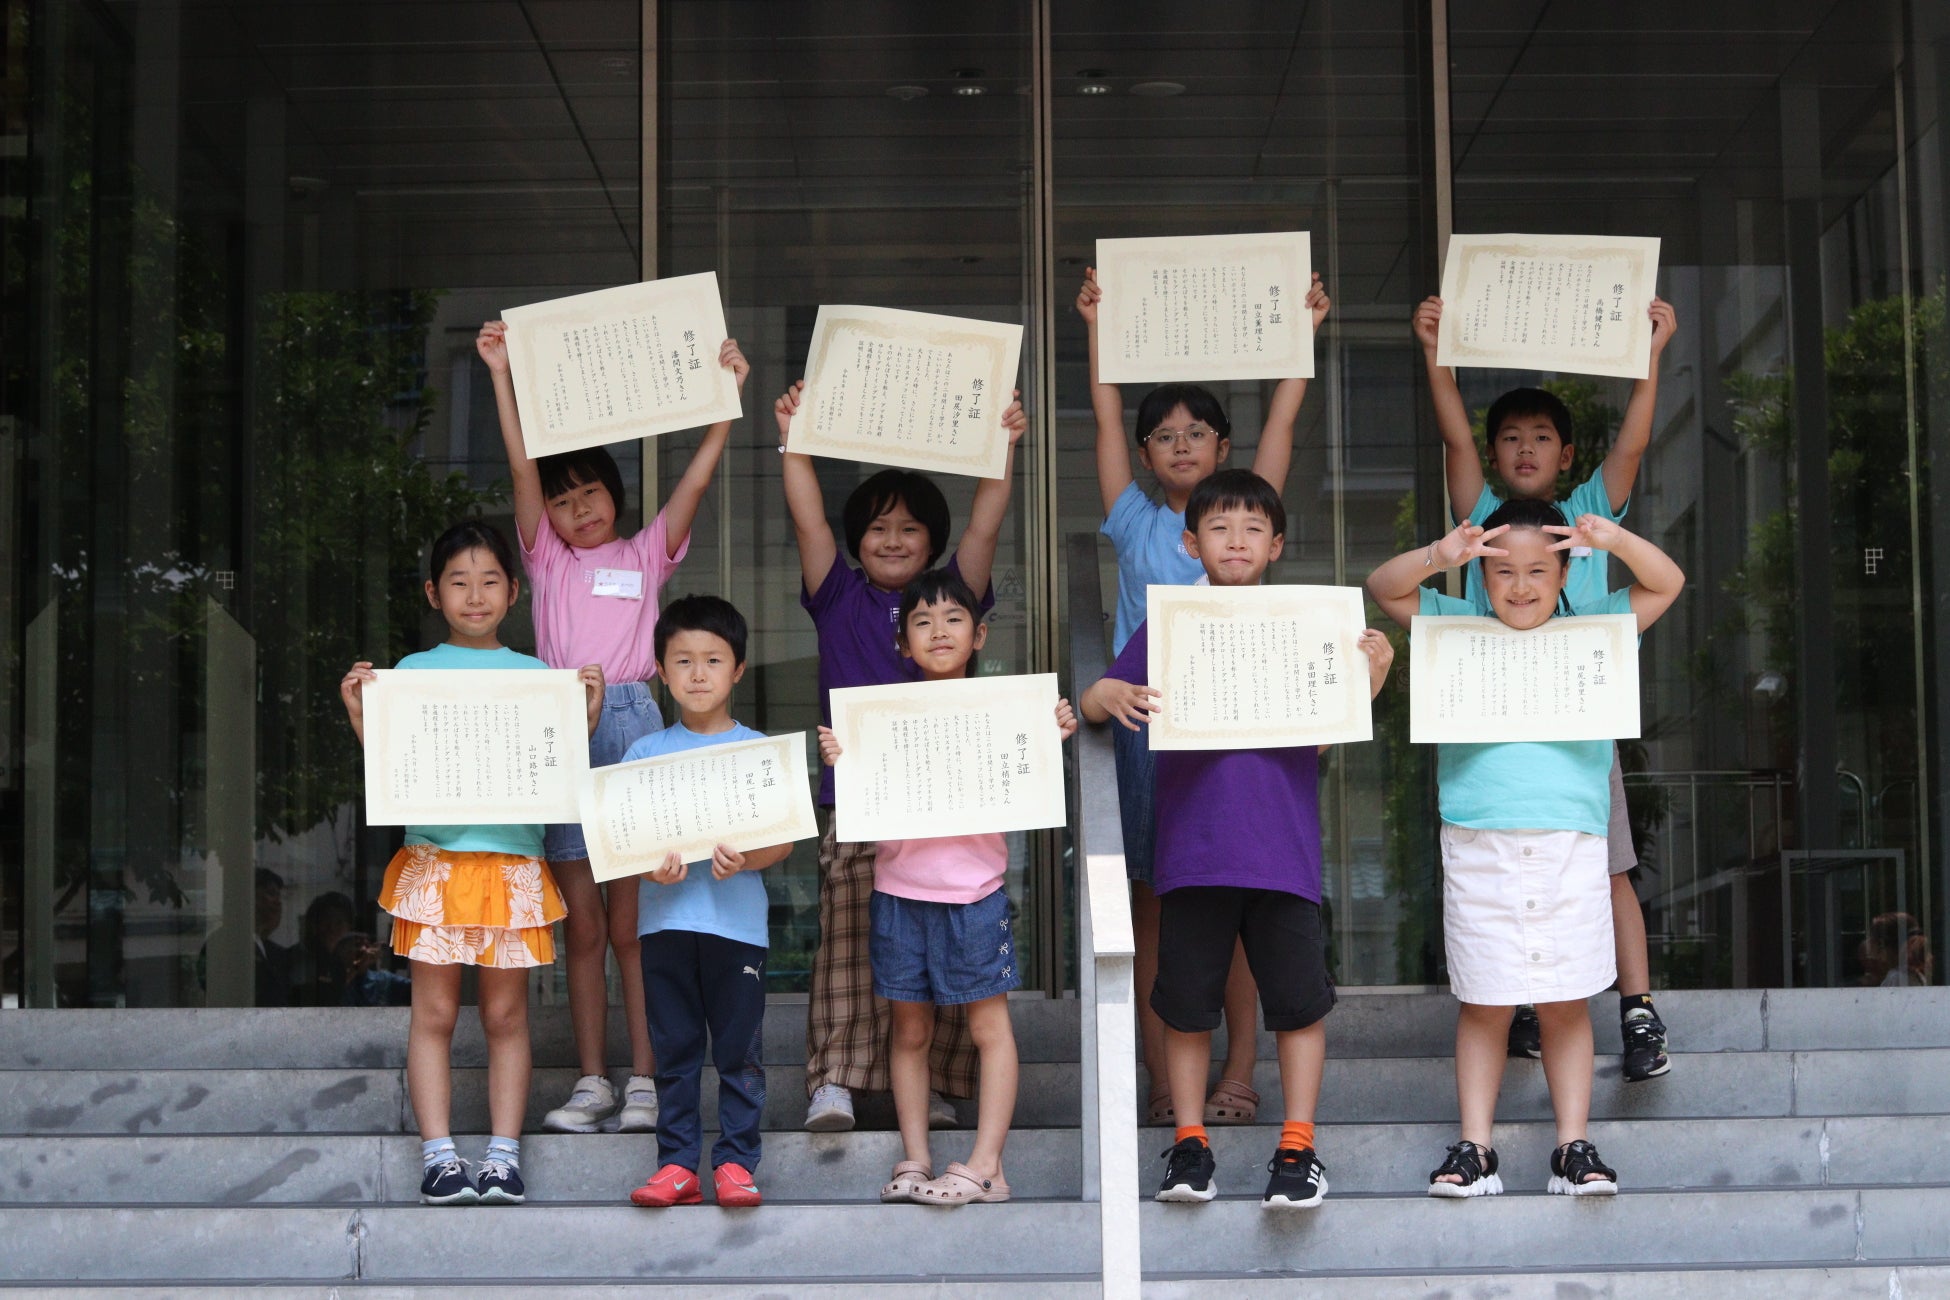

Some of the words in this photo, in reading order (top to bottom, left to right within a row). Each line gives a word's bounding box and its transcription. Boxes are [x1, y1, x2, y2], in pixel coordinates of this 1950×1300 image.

[1269, 285, 1283, 324] 修了証
[1610, 283, 1625, 322] 修了証
[683, 330, 703, 370] 修了証
[968, 378, 985, 419] 修了証
[1322, 642, 1338, 685] 修了証
[1592, 649, 1607, 685] 修了証
[1307, 661, 1318, 715] 富田理仁さん
[543, 726, 558, 767] 修了証
[1015, 733, 1031, 775] 修了証
[761, 758, 776, 788] 修了証
